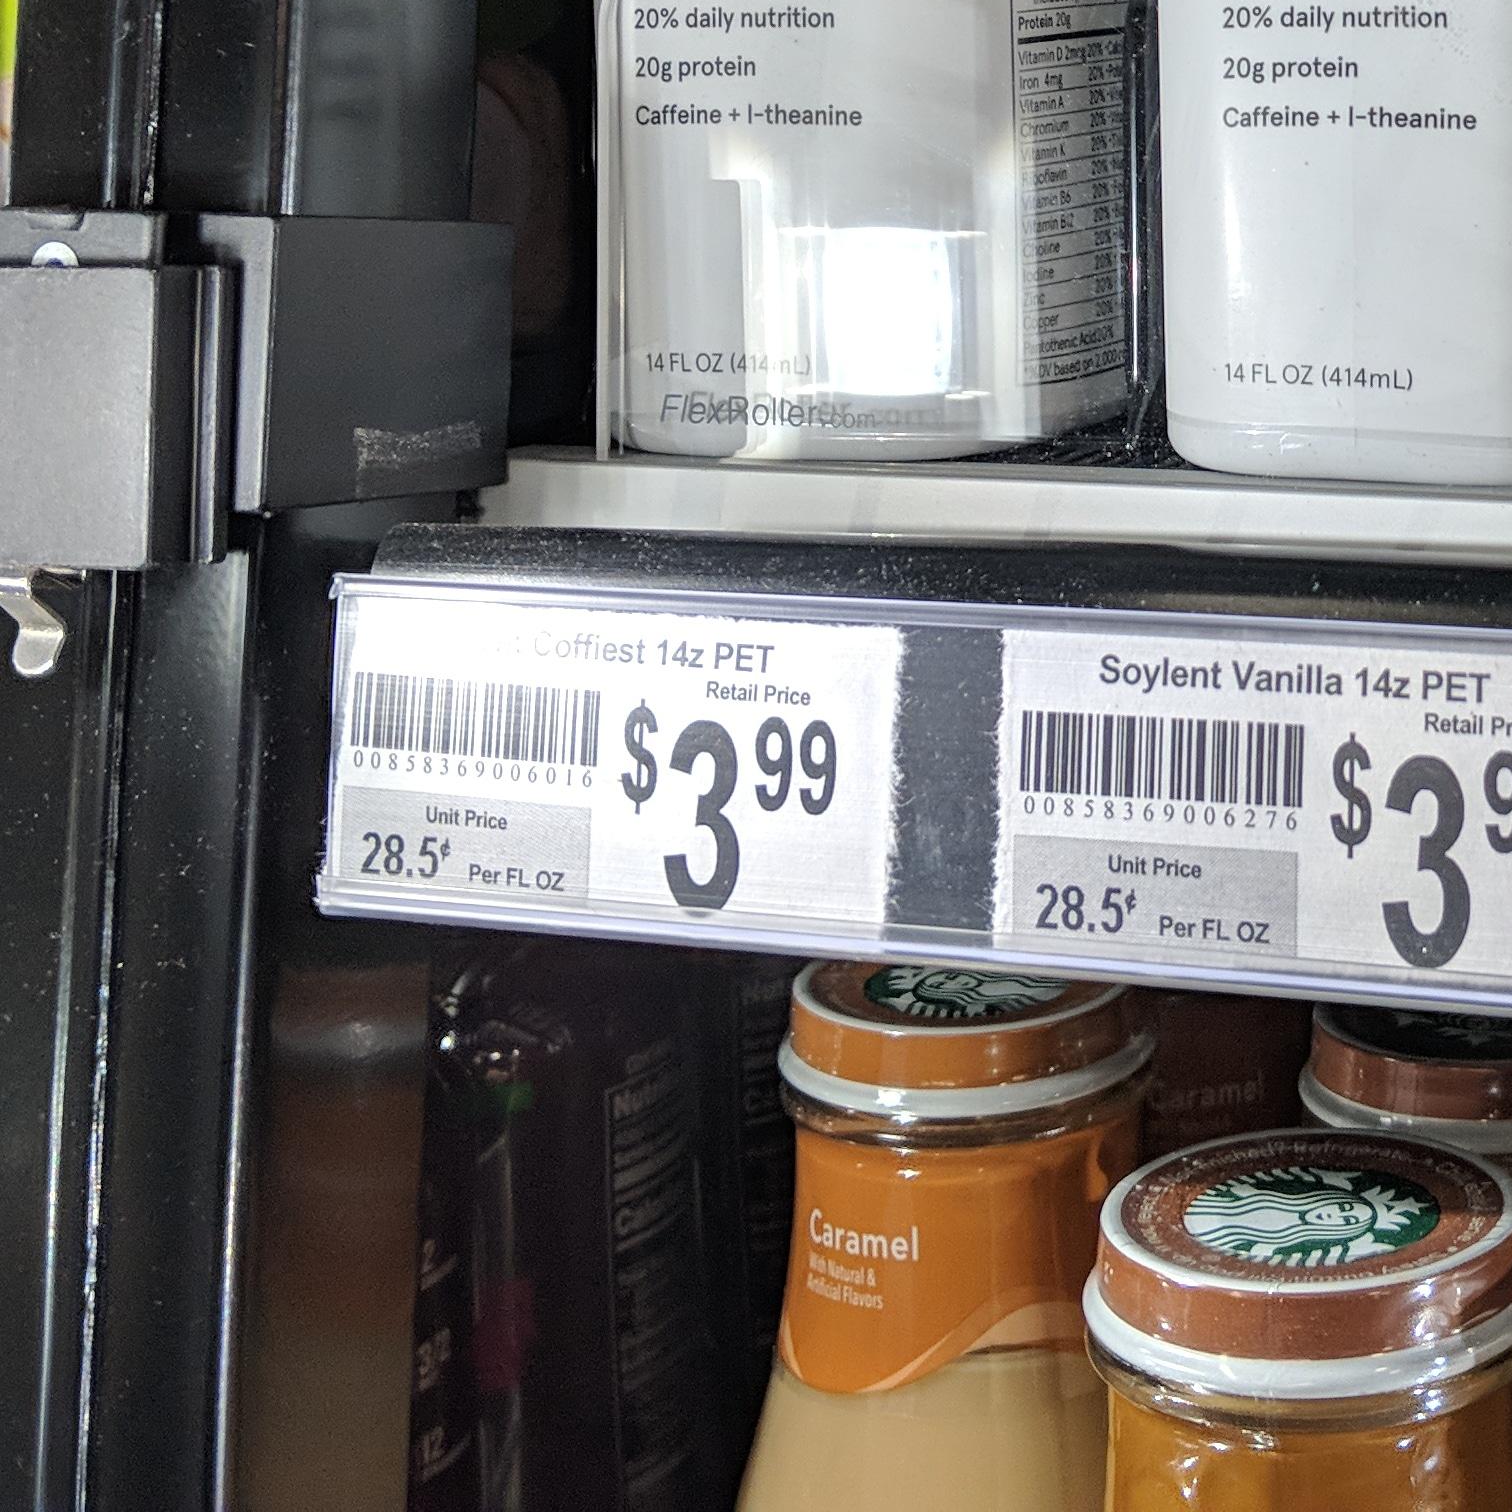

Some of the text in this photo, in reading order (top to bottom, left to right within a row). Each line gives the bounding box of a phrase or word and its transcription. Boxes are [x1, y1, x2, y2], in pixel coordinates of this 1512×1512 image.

[633, 7, 836, 33] 20% daily nutrition
[1018, 17, 1053, 31] Protein
[1222, 5, 1448, 33] 20% daily nutrition
[635, 55, 757, 82] 20g protein
[1223, 56, 1359, 83] 20g protein
[635, 104, 722, 126] Caffeine
[1223, 107, 1320, 128] Caffeine
[647, 353, 665, 373] 14
[669, 353, 691, 372] FL
[696, 353, 724, 373] OZ
[1225, 363, 1413, 391] 14 FL OZ (414mL)
[656, 640, 704, 669] 14z
[714, 642, 775, 674] PET
[1100, 655, 1492, 703] Soylent Vanilla 14z PET
[706, 681, 811, 706] Retail Price
[1424, 713, 1483, 736] Retail
[426, 806, 508, 830] Unit Price
[469, 863, 501, 885] Per
[506, 867, 530, 888] FL
[536, 871, 565, 892] OZ
[1108, 855, 1202, 879] Unit Price
[1159, 916, 1195, 939] Per
[1202, 919, 1230, 941] FL
[1237, 921, 1271, 945] OZ
[809, 1208, 919, 1262] Caramel
